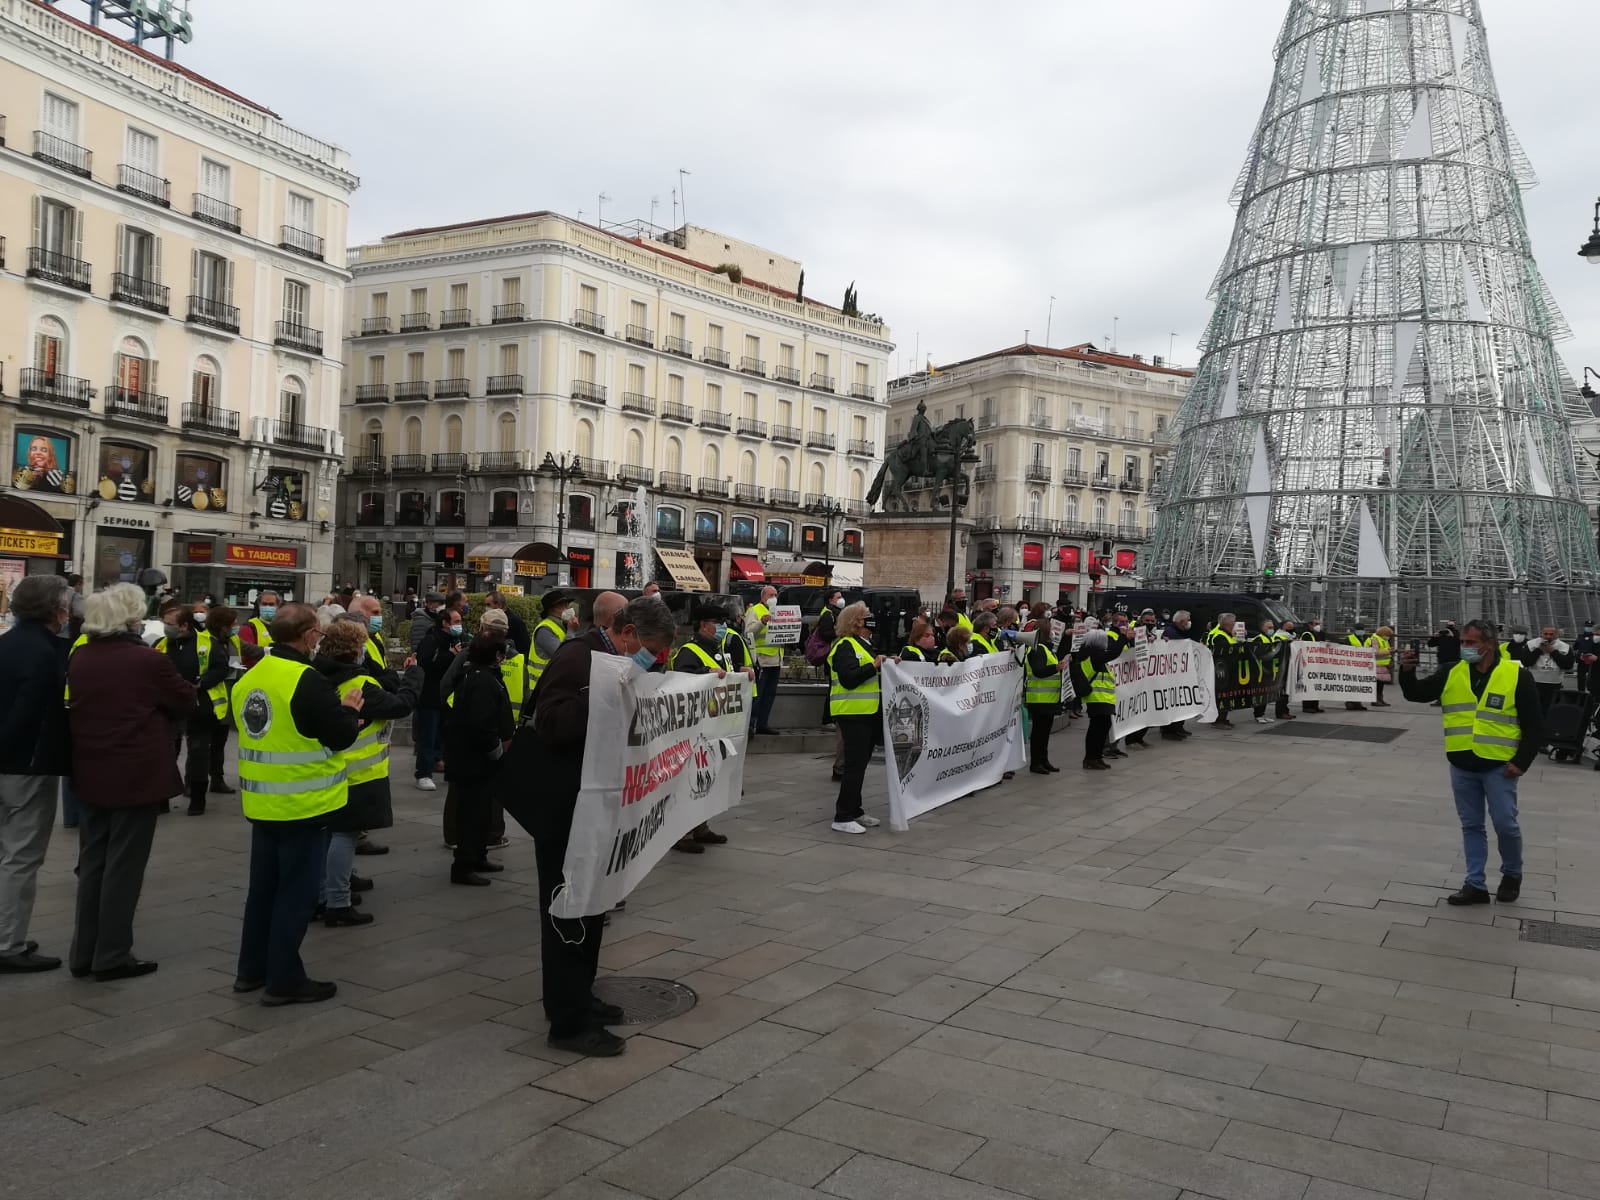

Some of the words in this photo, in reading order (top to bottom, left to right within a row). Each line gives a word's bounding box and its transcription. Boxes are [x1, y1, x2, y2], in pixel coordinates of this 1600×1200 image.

[104, 516, 150, 528] SEPHORA
[0, 535, 36, 549] TICKETS
[248, 550, 290, 561] TABACOS
[569, 551, 591, 562] Orange
[661, 550, 690, 559] CHANGE
[1147, 653, 1178, 676] DIGNAS
[1181, 652, 1189, 673] SI
[1323, 683, 1344, 692] JUNTOS
[927, 747, 943, 760] POR
[943, 746, 952, 757] LA
